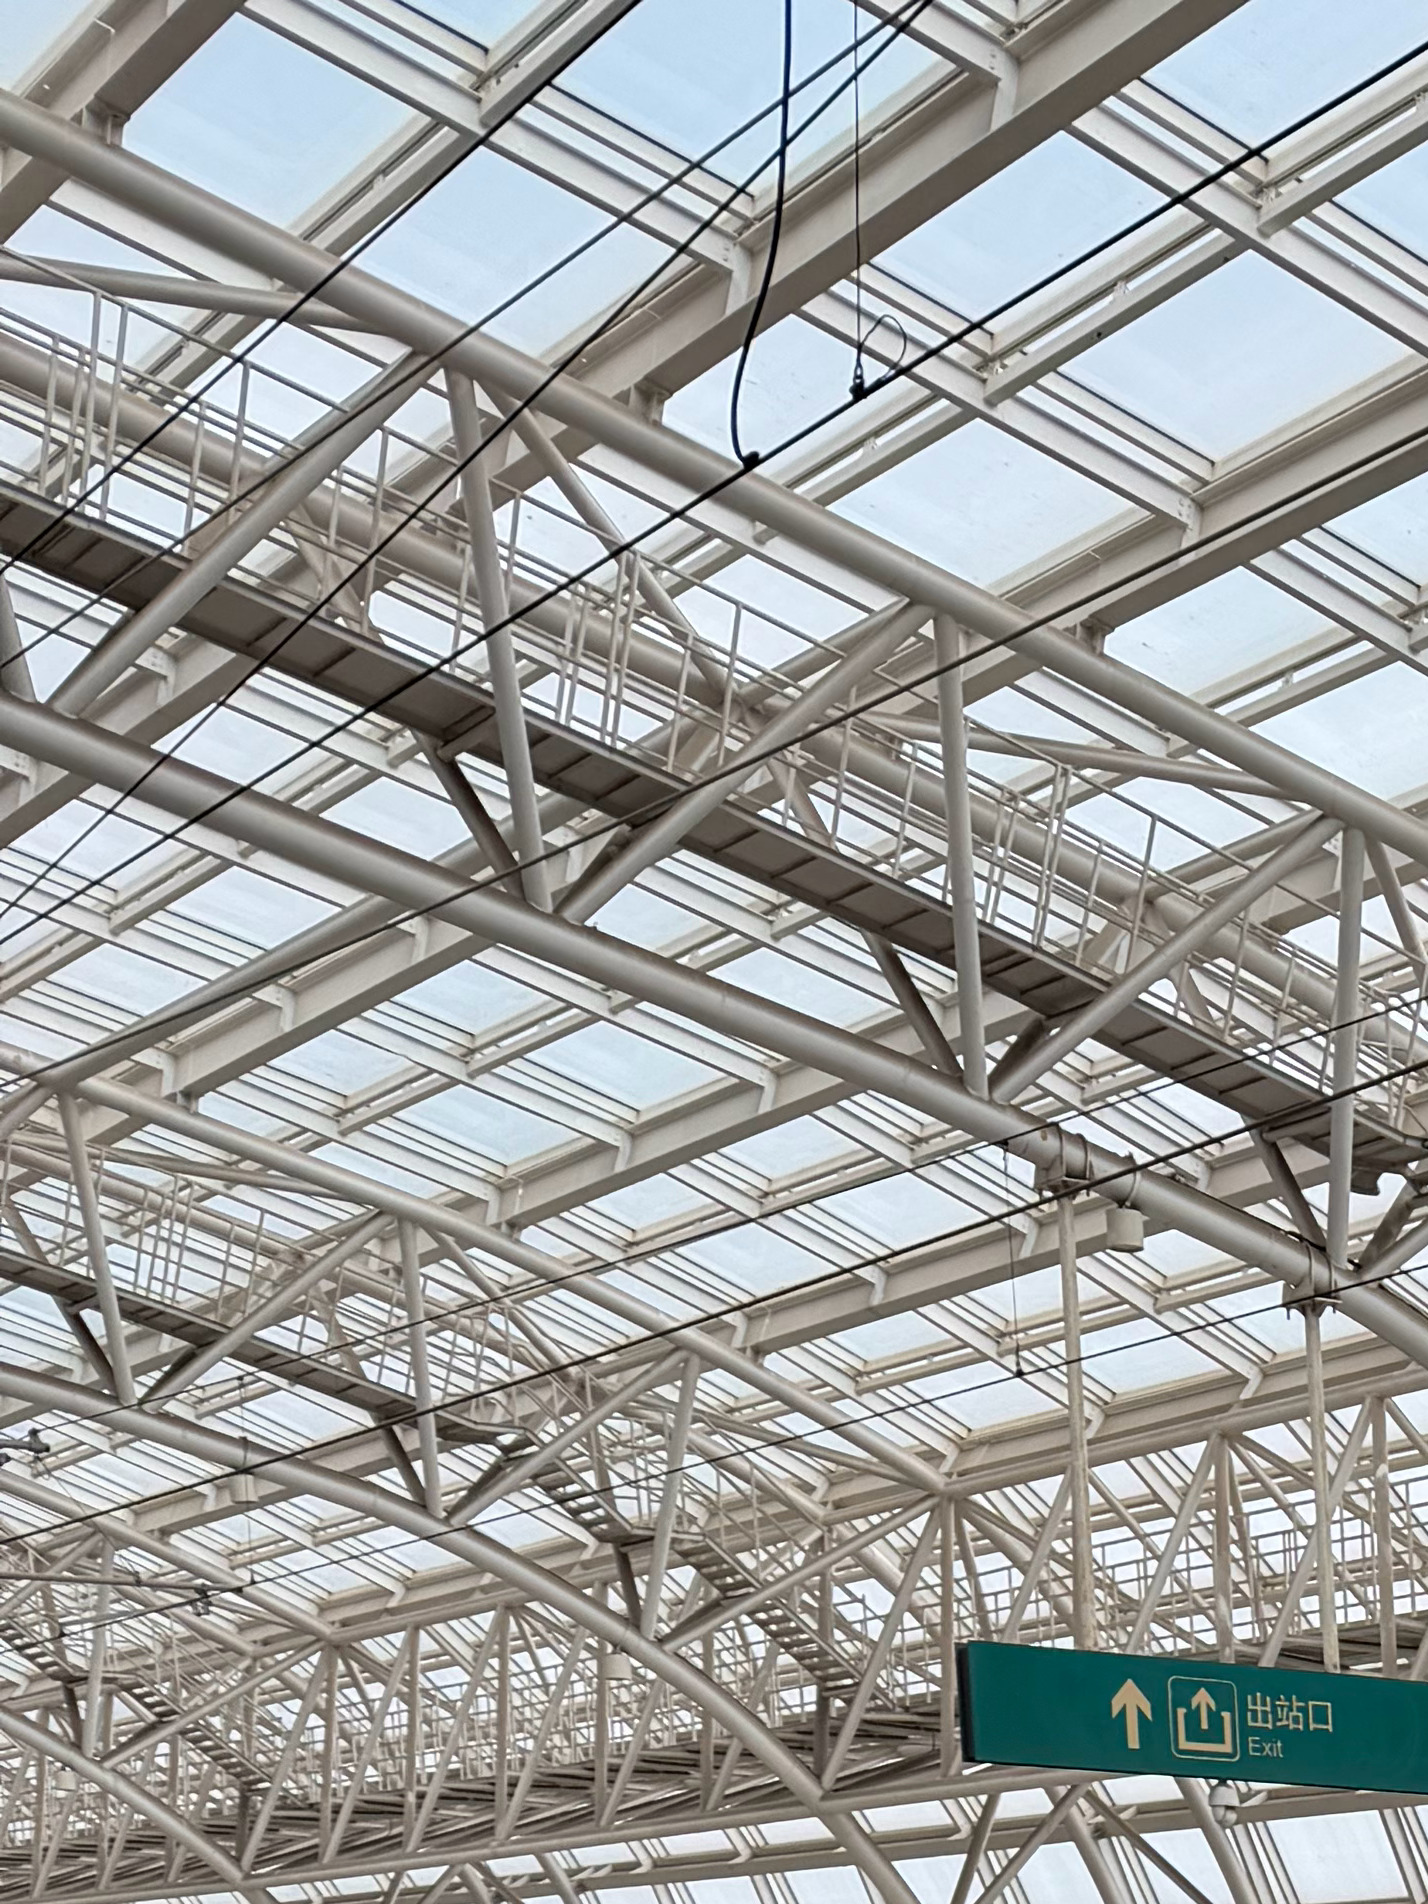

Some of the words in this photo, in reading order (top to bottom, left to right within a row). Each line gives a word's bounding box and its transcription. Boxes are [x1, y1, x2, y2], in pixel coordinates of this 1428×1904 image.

[1246, 1691, 1333, 1733] 出站口
[1248, 1737, 1284, 1759] Exit
